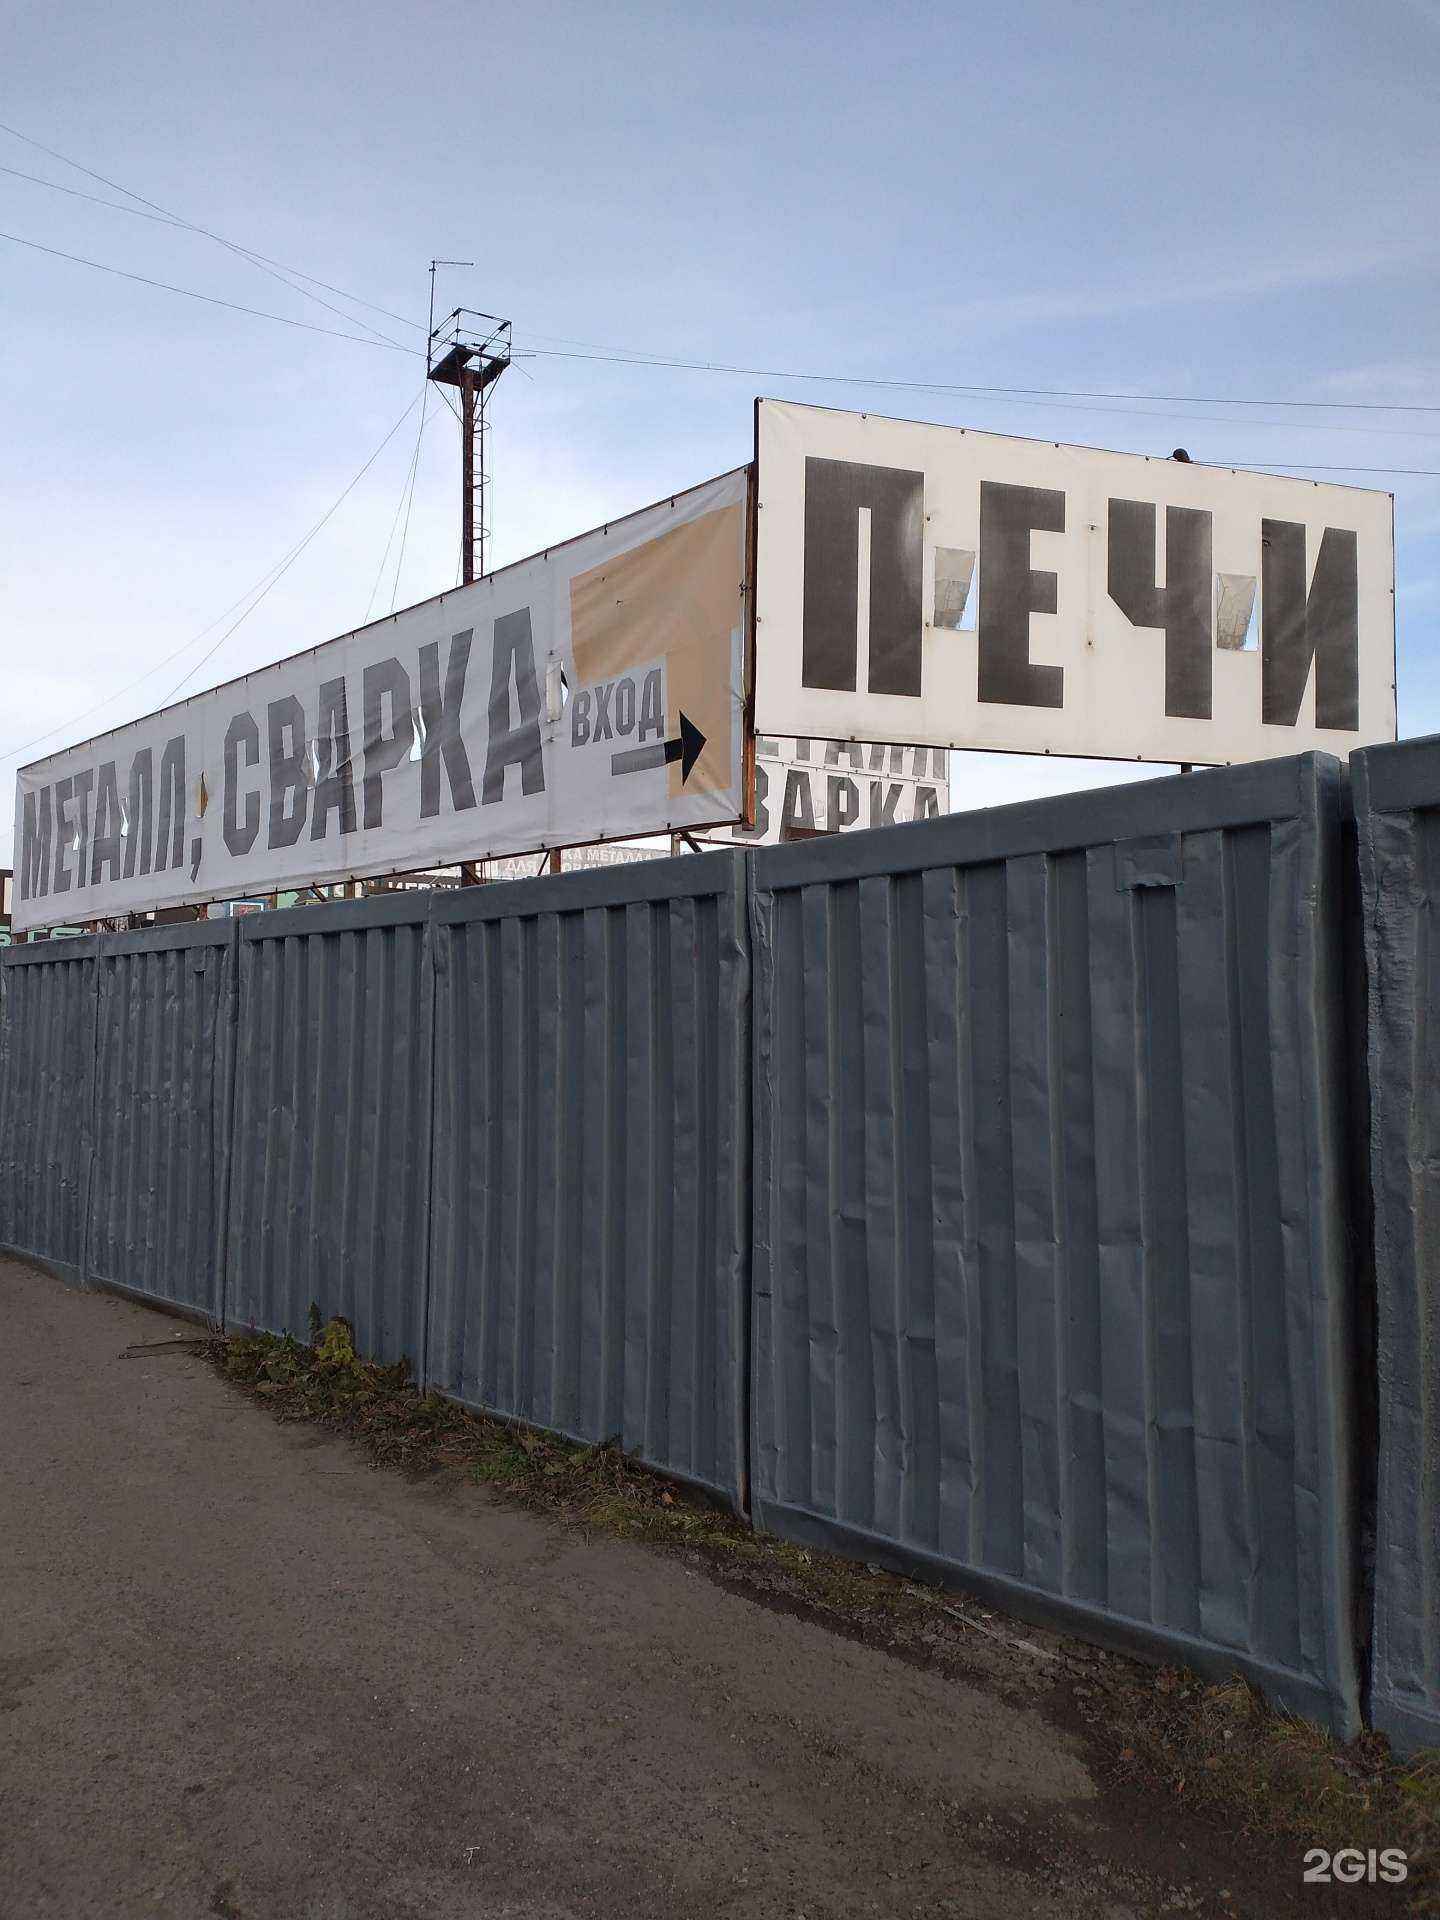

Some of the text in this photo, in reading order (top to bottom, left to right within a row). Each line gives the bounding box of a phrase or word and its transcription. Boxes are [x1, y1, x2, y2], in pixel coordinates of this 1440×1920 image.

[801, 456, 1359, 731] ПЕЧИ
[20, 606, 545, 900] МЕТАЛЛ, СВАРКА
[571, 668, 665, 747] ВХОД
[725, 764, 941, 844] ВАРКА
